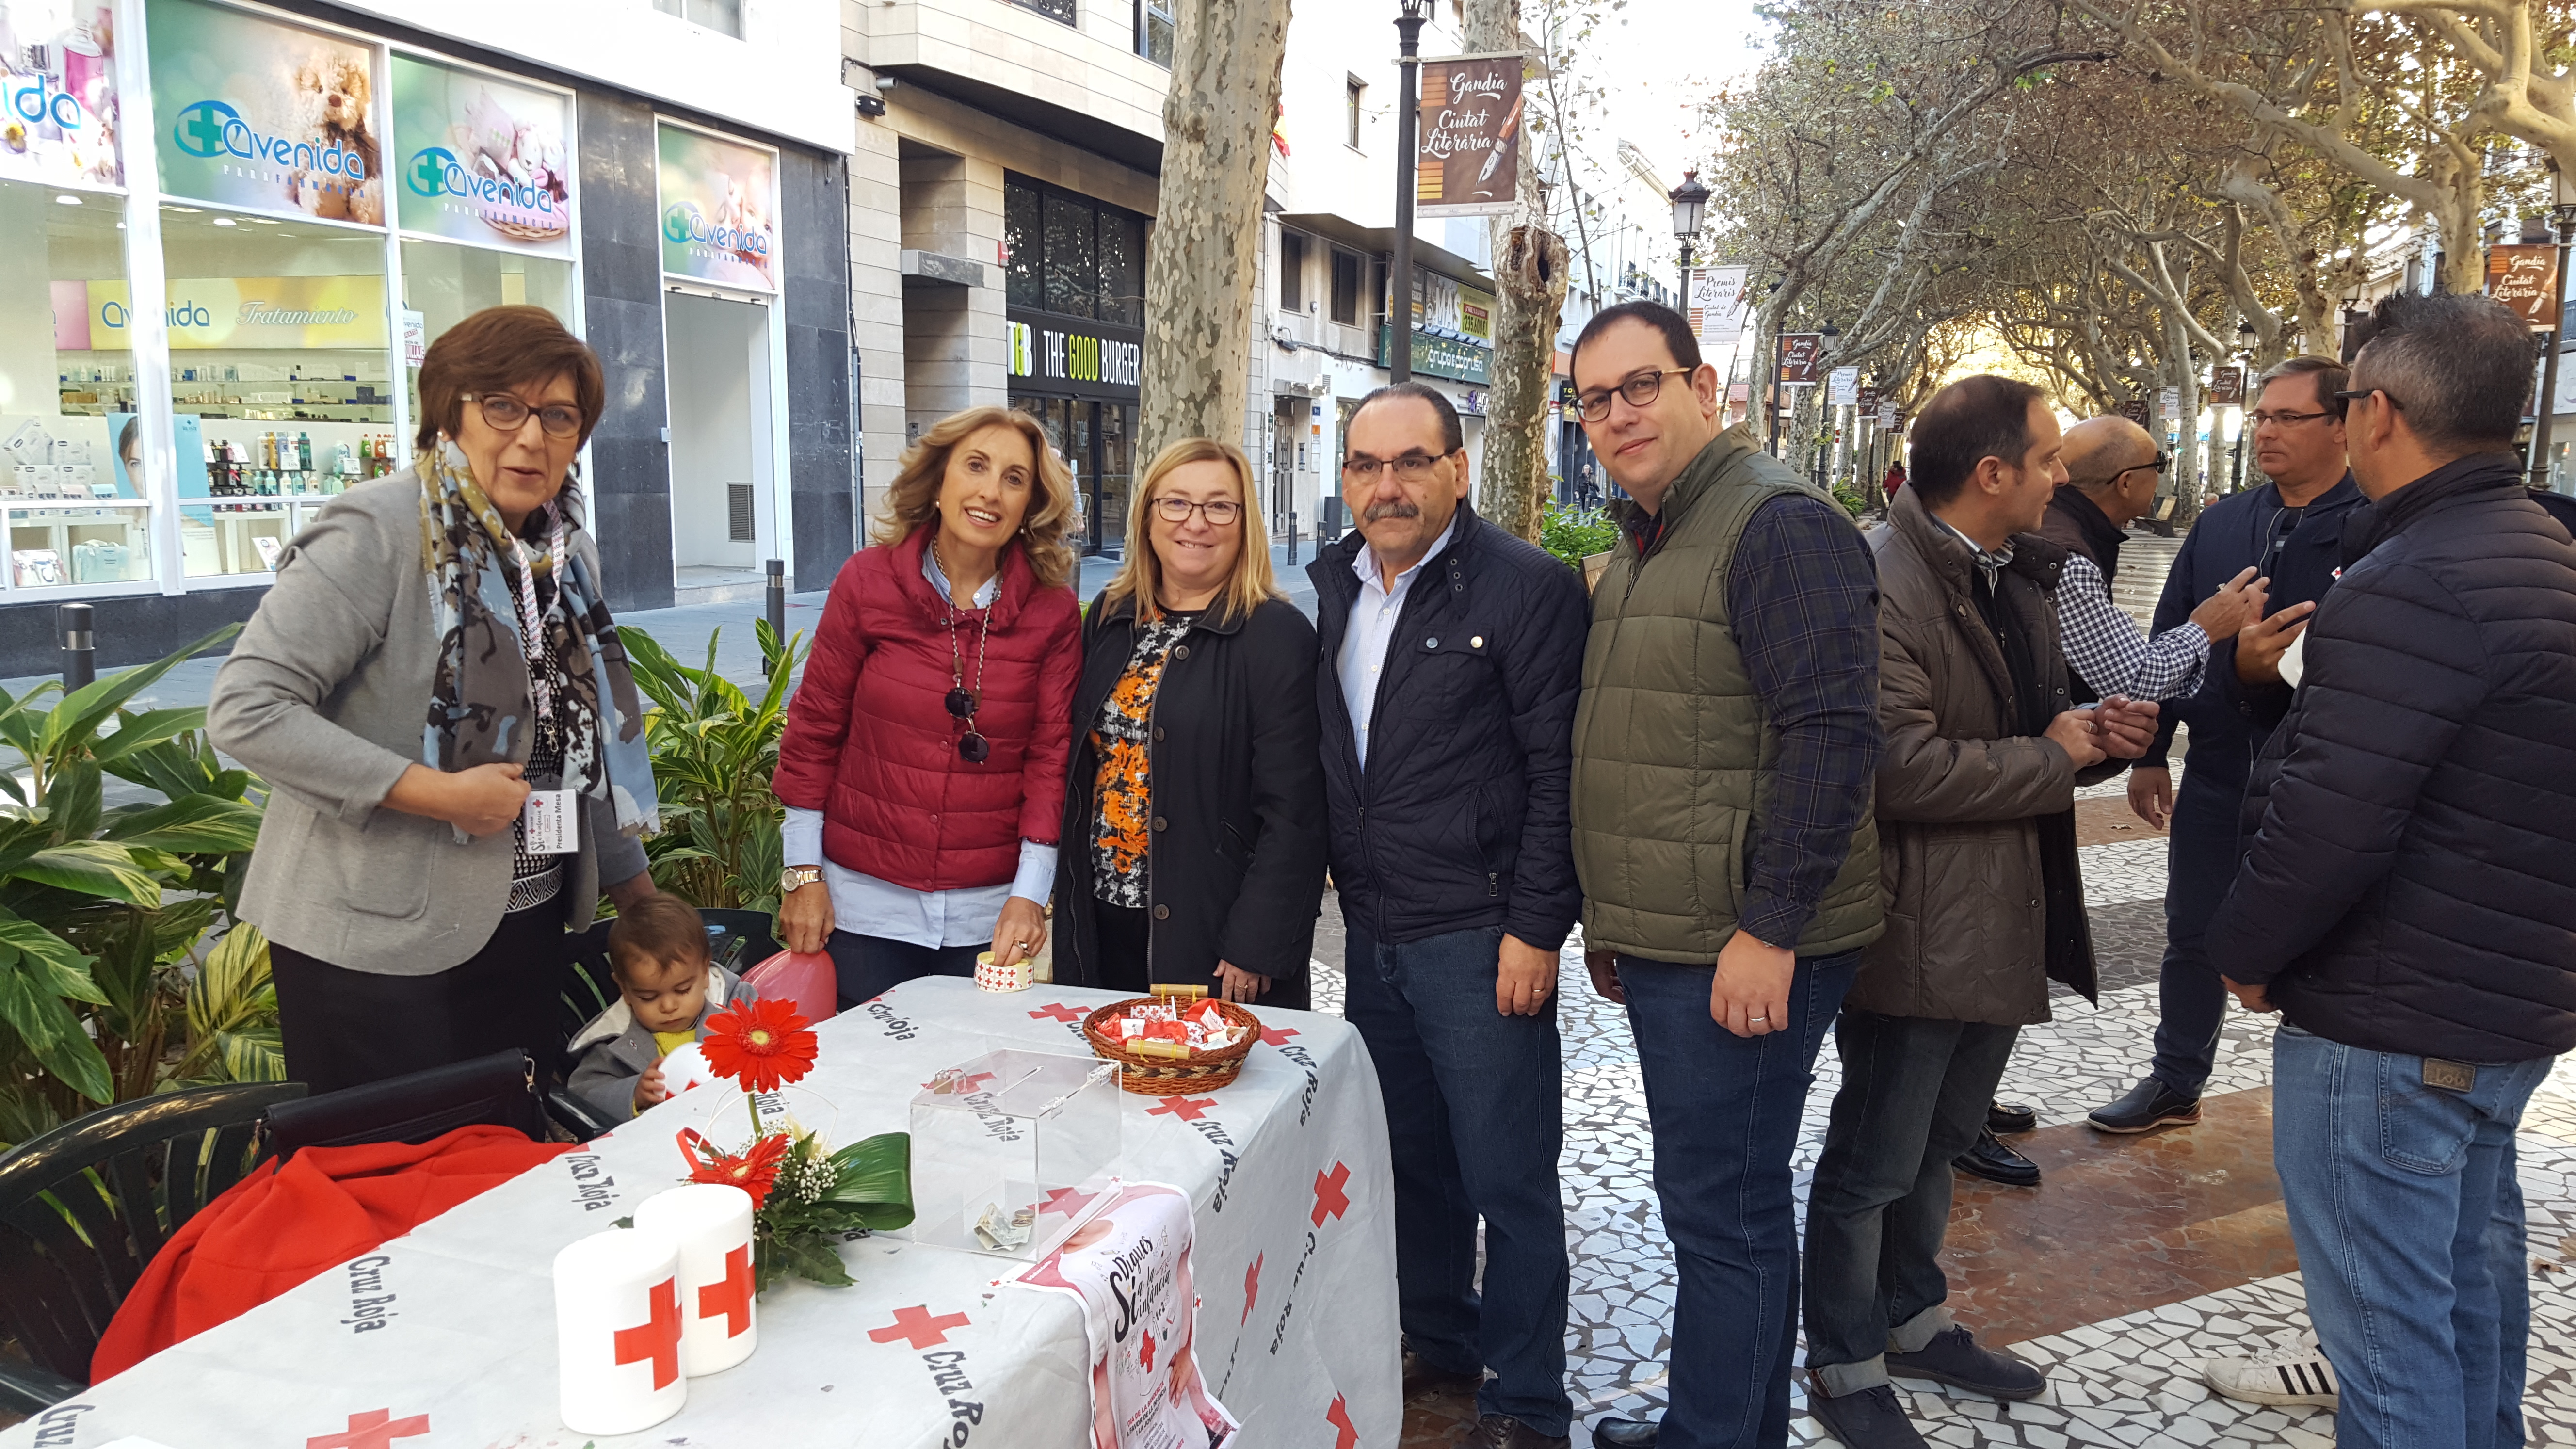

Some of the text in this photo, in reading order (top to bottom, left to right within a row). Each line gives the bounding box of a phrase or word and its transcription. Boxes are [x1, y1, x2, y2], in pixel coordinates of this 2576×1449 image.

[1450, 72, 1508, 104] Gandia
[1439, 109, 1490, 129] Ciutat
[1421, 128, 1494, 159] Literària
[2510, 255, 2546, 272] Gandia
[1707, 276, 1737, 288] Premis
[2501, 274, 2537, 285] Ciutat
[1694, 286, 1738, 302] Literaris
[2489, 285, 2538, 302] Literària
[101, 300, 210, 328] avida
[236, 301, 359, 325] Tratamiento
[404, 328, 418, 338] RATIS
[1792, 339, 1813, 350] Gandia
[1007, 321, 1140, 386] TGB THE GOOD BURGER
[883, 1017, 919, 1041] oja
[1278, 1046, 1318, 1127] Cruz Roja
[755, 1091, 790, 1115] Roja
[963, 1092, 1025, 1142] Cruz Roja
[1191, 1121, 1240, 1213] Cruz Roja
[565, 1155, 620, 1211] Cruz Roja
[1112, 1236, 1153, 1281] Digues
[1147, 1266, 1155, 1287] la
[340, 1256, 399, 1334] Cruz Roja
[1270, 1294, 1292, 1355] Roja
[922, 1351, 973, 1396] Cruz
[33, 1404, 96, 1449] Cruz
[1129, 1417, 1143, 1435] FAVOR
[1143, 1412, 1149, 1421] DE
